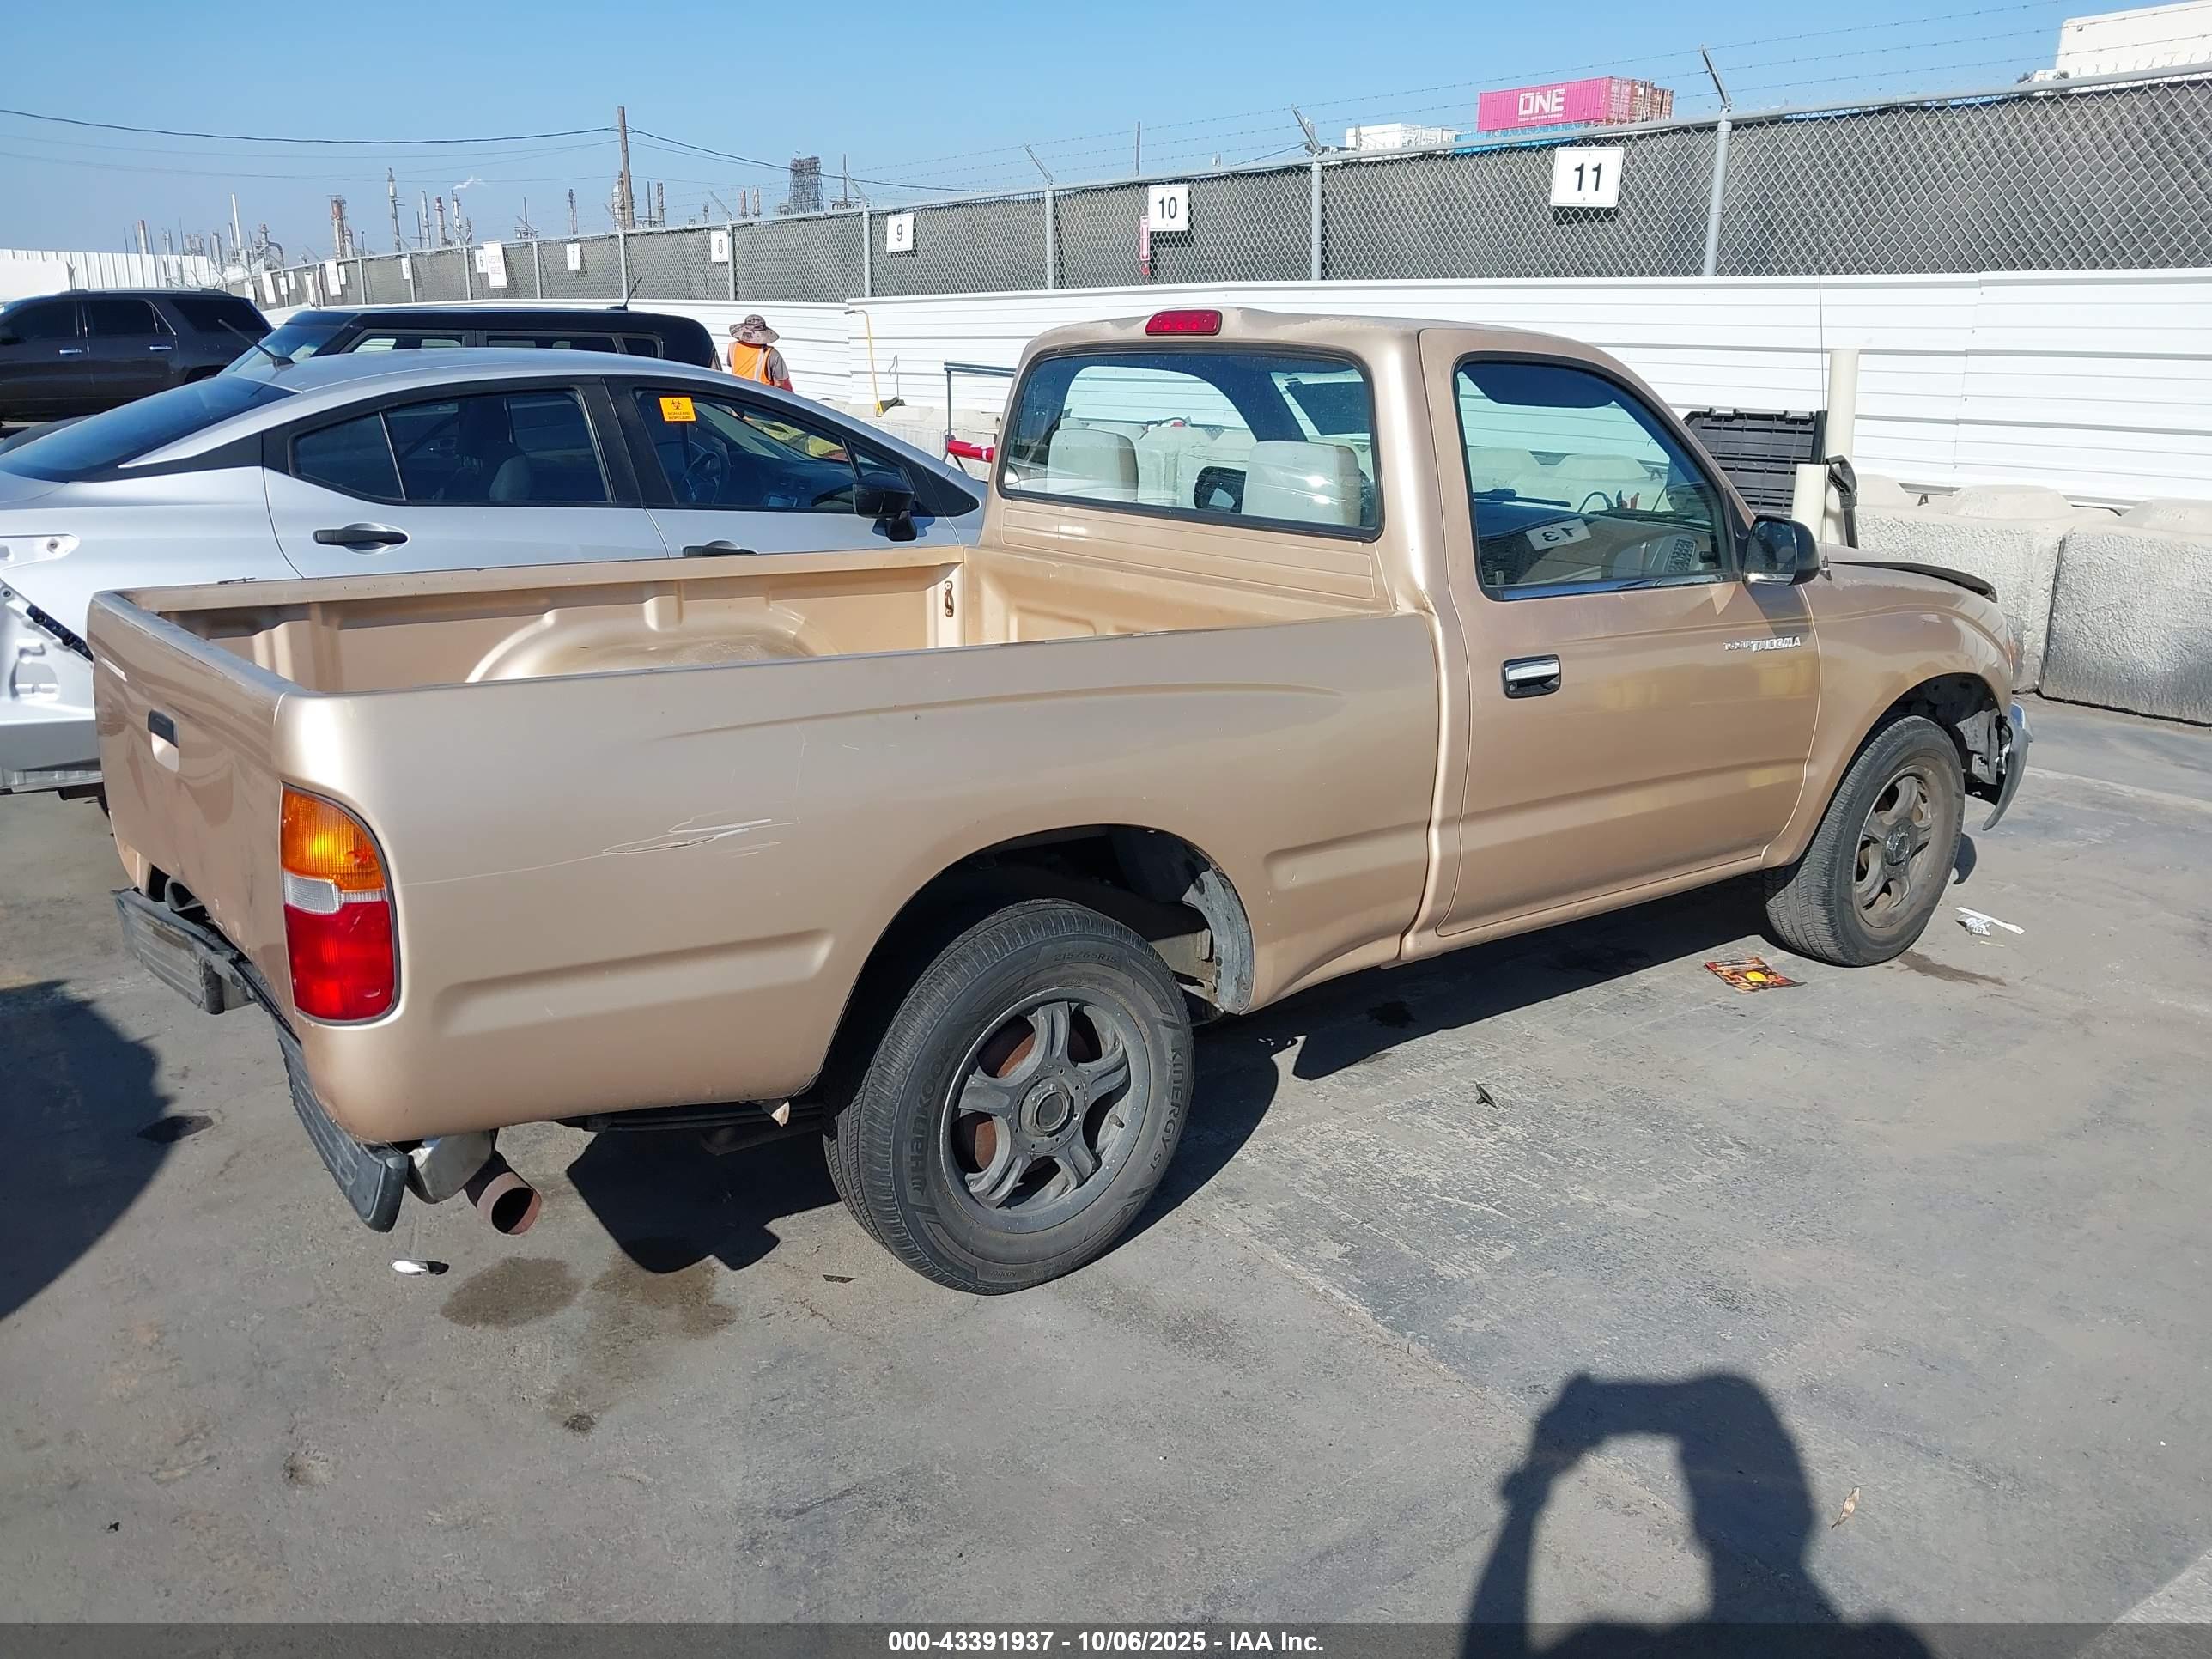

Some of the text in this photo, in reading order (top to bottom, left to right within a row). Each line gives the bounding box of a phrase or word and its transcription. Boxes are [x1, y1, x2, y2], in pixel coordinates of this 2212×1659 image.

[1518, 88, 1566, 116] ONE
[1574, 162, 1602, 191] 11
[1158, 196, 1177, 220] 10
[896, 223, 903, 242] 9
[717, 239, 724, 254] 8
[1752, 636, 1801, 652] TACOMA
